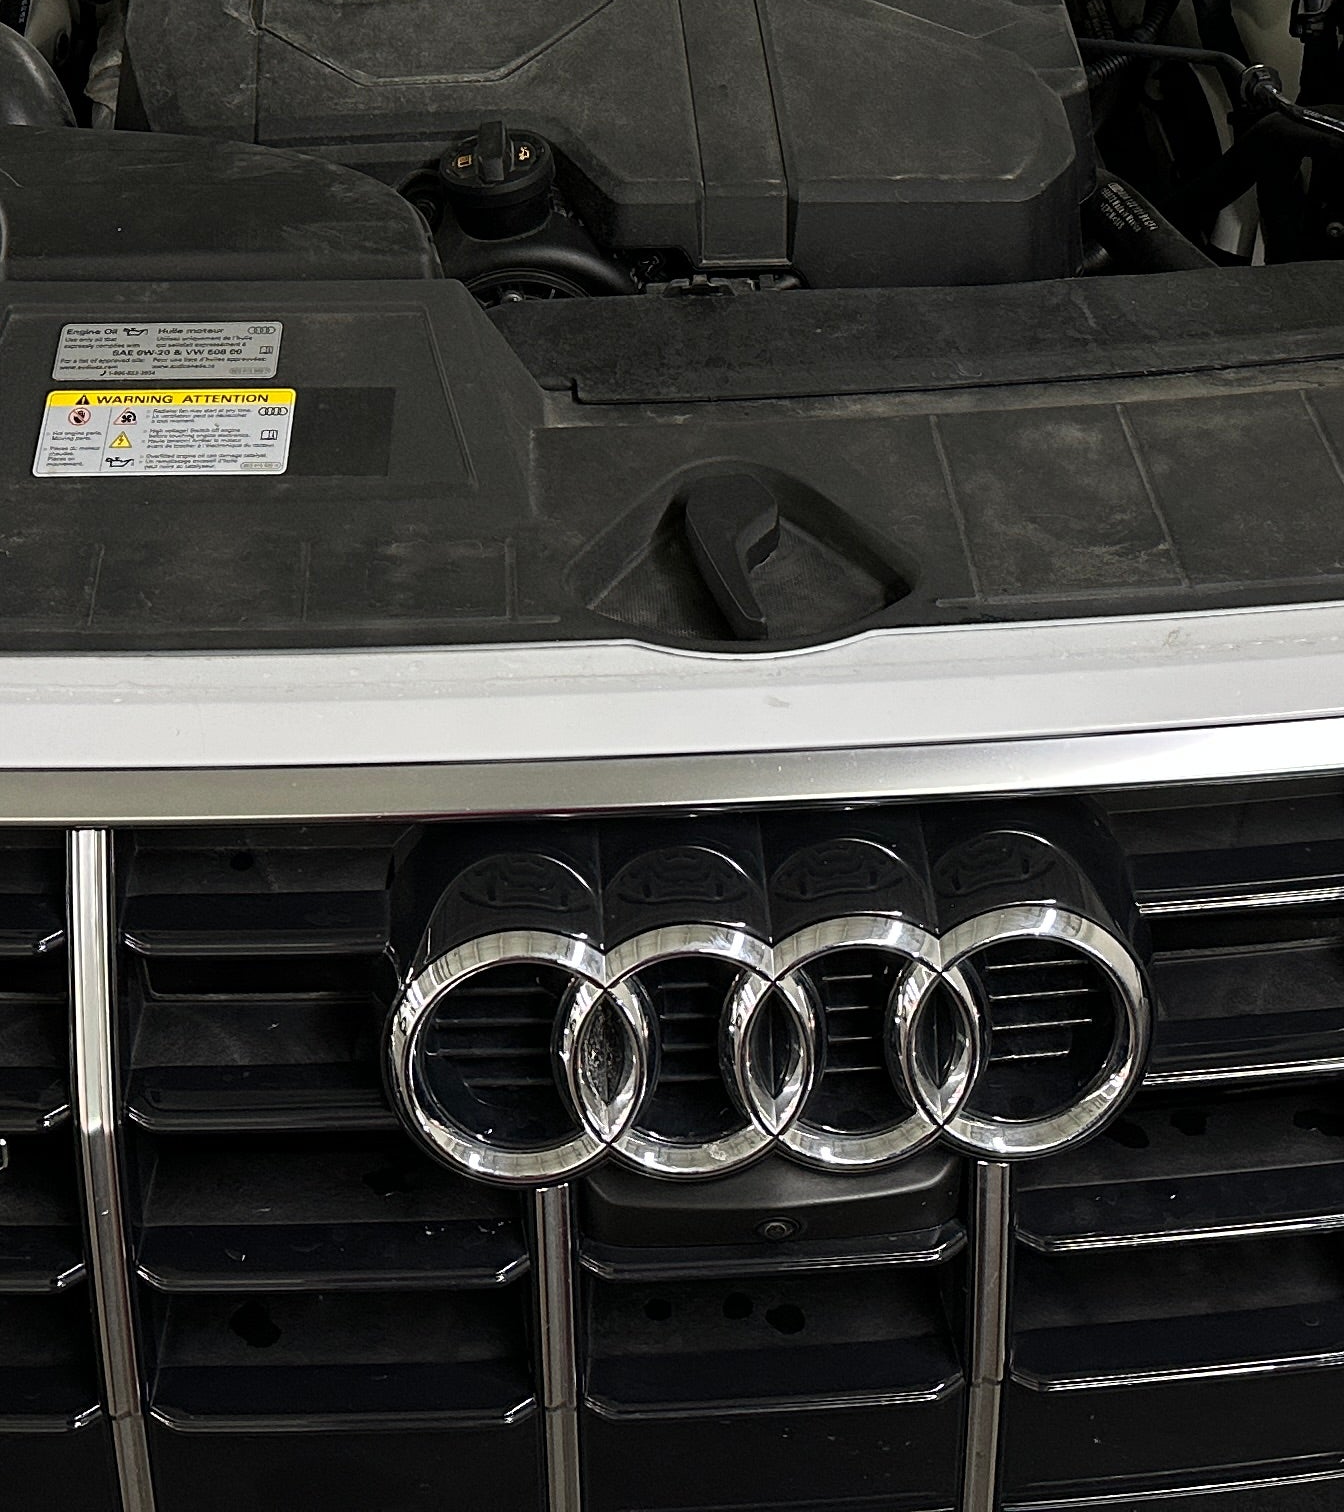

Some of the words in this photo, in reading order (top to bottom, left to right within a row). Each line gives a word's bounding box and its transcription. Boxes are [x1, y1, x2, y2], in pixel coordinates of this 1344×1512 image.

[66, 328, 101, 336] Engine
[112, 349, 134, 357] SAE
[97, 395, 173, 404] WARNING
[182, 394, 269, 404] ATTENTION
